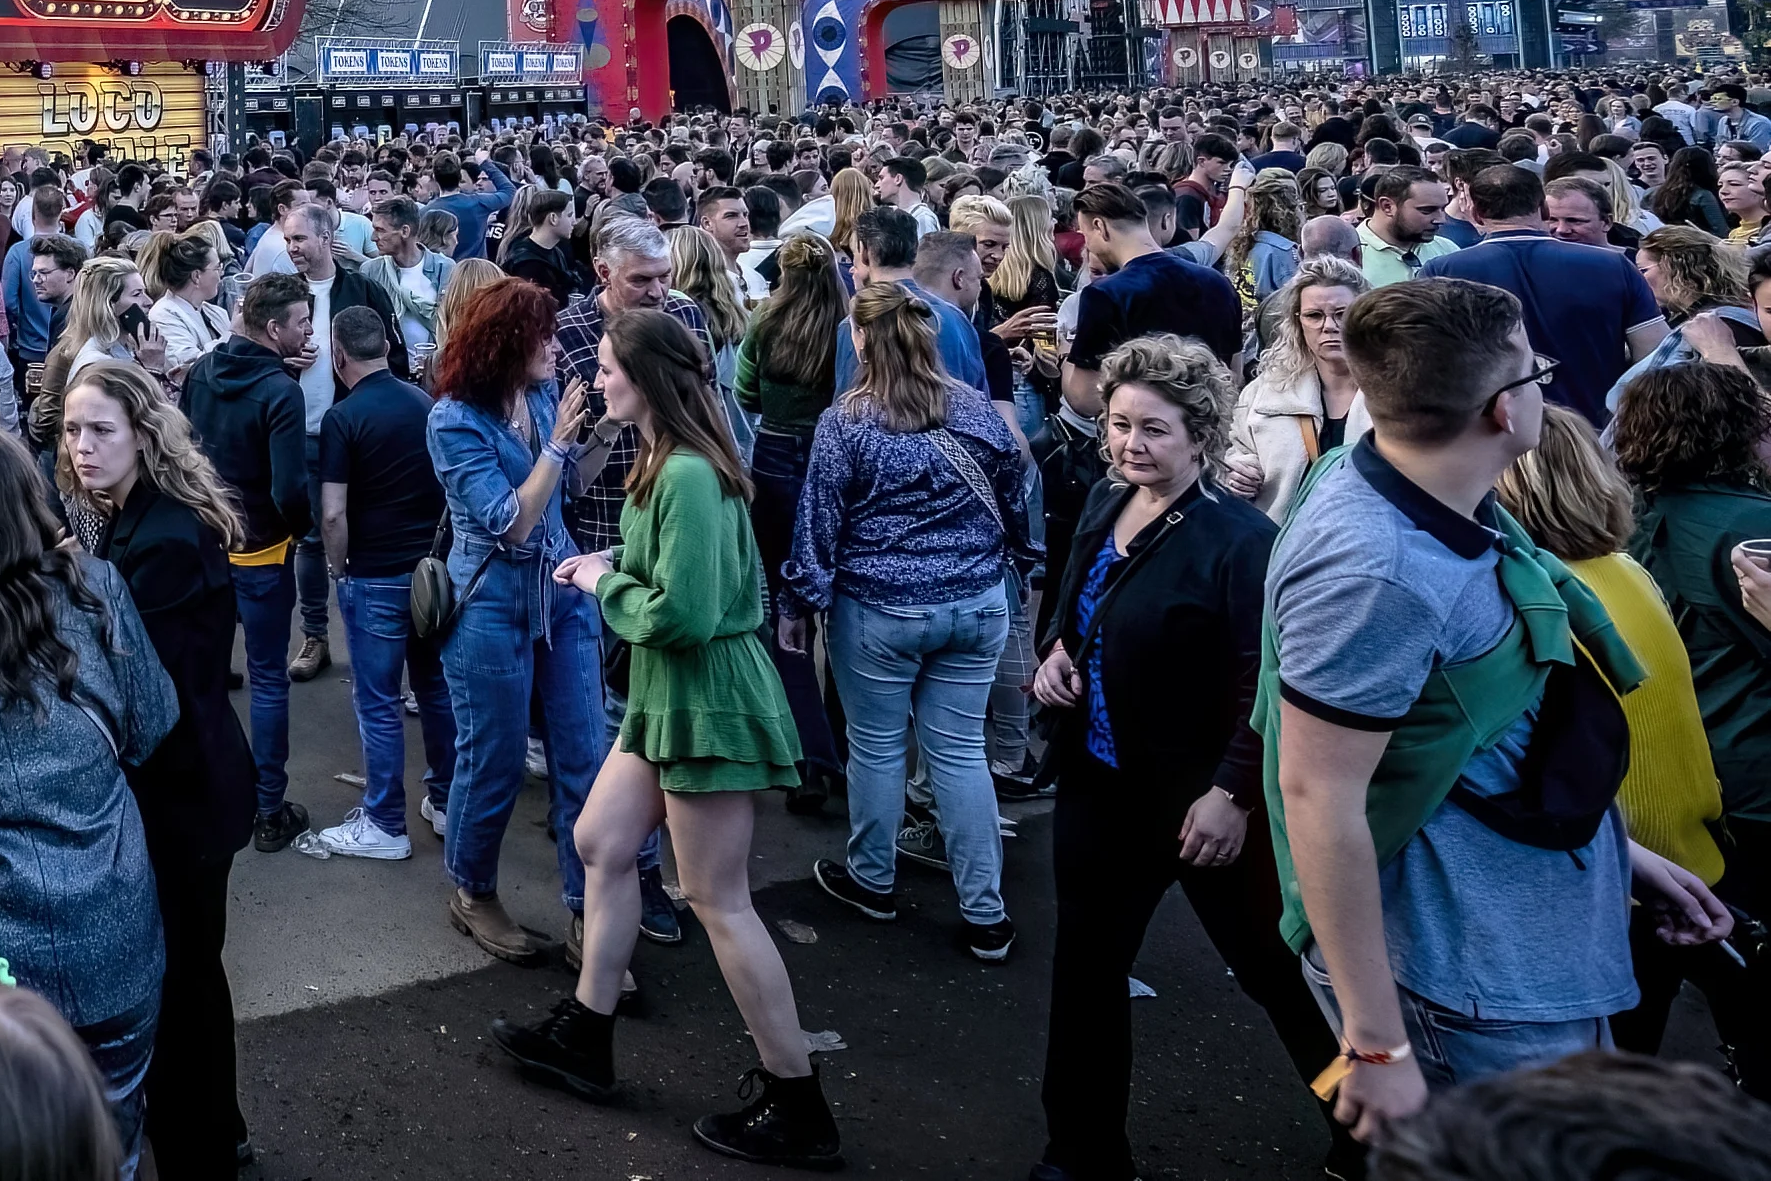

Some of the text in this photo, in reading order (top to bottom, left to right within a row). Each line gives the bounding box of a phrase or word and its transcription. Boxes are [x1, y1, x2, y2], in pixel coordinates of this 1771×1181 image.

[333, 55, 448, 69] TOKENS TOKENS TOKENS
[490, 57, 574, 68] TOKENS TOKENS TOKENS
[37, 81, 164, 137] LOCO
